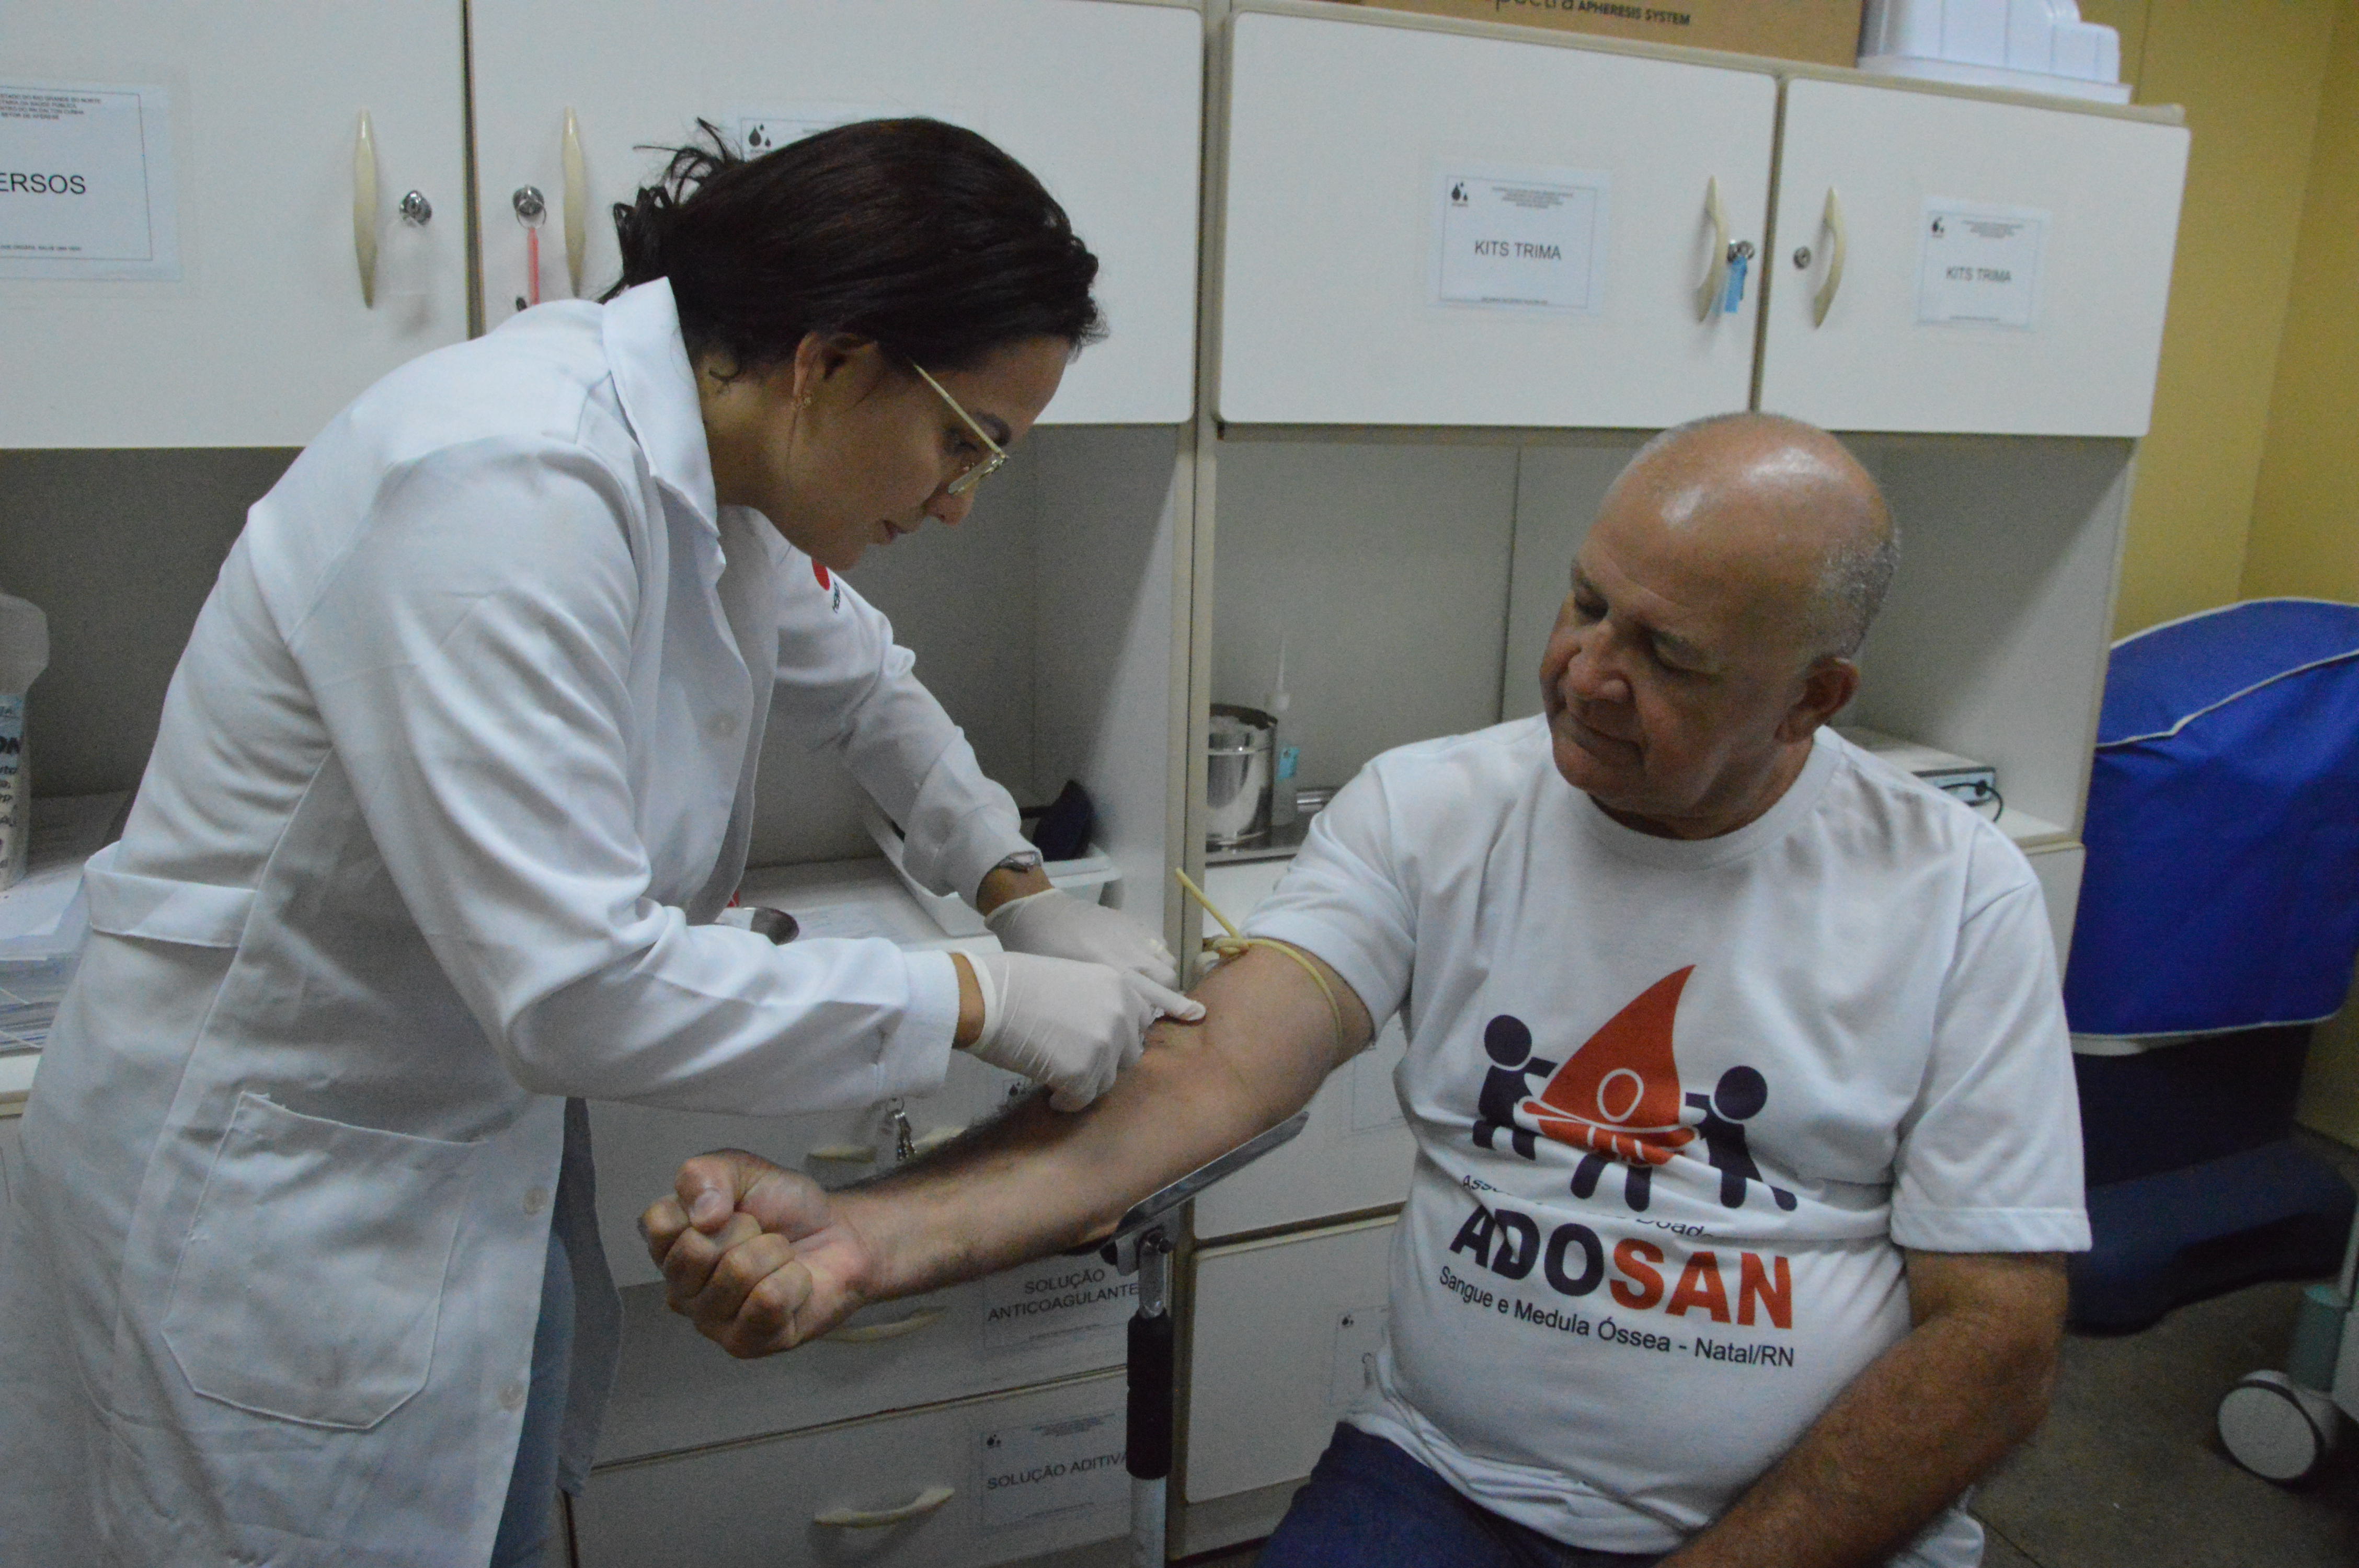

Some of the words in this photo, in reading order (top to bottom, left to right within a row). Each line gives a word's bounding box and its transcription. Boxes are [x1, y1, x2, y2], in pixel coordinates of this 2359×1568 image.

[1645, 8, 1690, 25] SYSTEM
[1474, 240, 1509, 257] KITS
[1515, 242, 1562, 260] TRIMA
[1946, 266, 1974, 281] KITS
[1977, 267, 2011, 282] TRIMA
[1449, 1204, 1792, 1330] ADOSAN
[1024, 1267, 1105, 1295] SOLUÇÃO
[988, 1282, 1139, 1322] ANTICOAGULANTE
[1439, 1265, 1493, 1308] Sangue
[1497, 1299, 1509, 1313] e
[1515, 1300, 1590, 1336] Medula
[1597, 1317, 1670, 1352] Óssea
[1694, 1337, 1794, 1367] Natal/RN
[987, 1463, 1066, 1490] SOLUÇÃO
